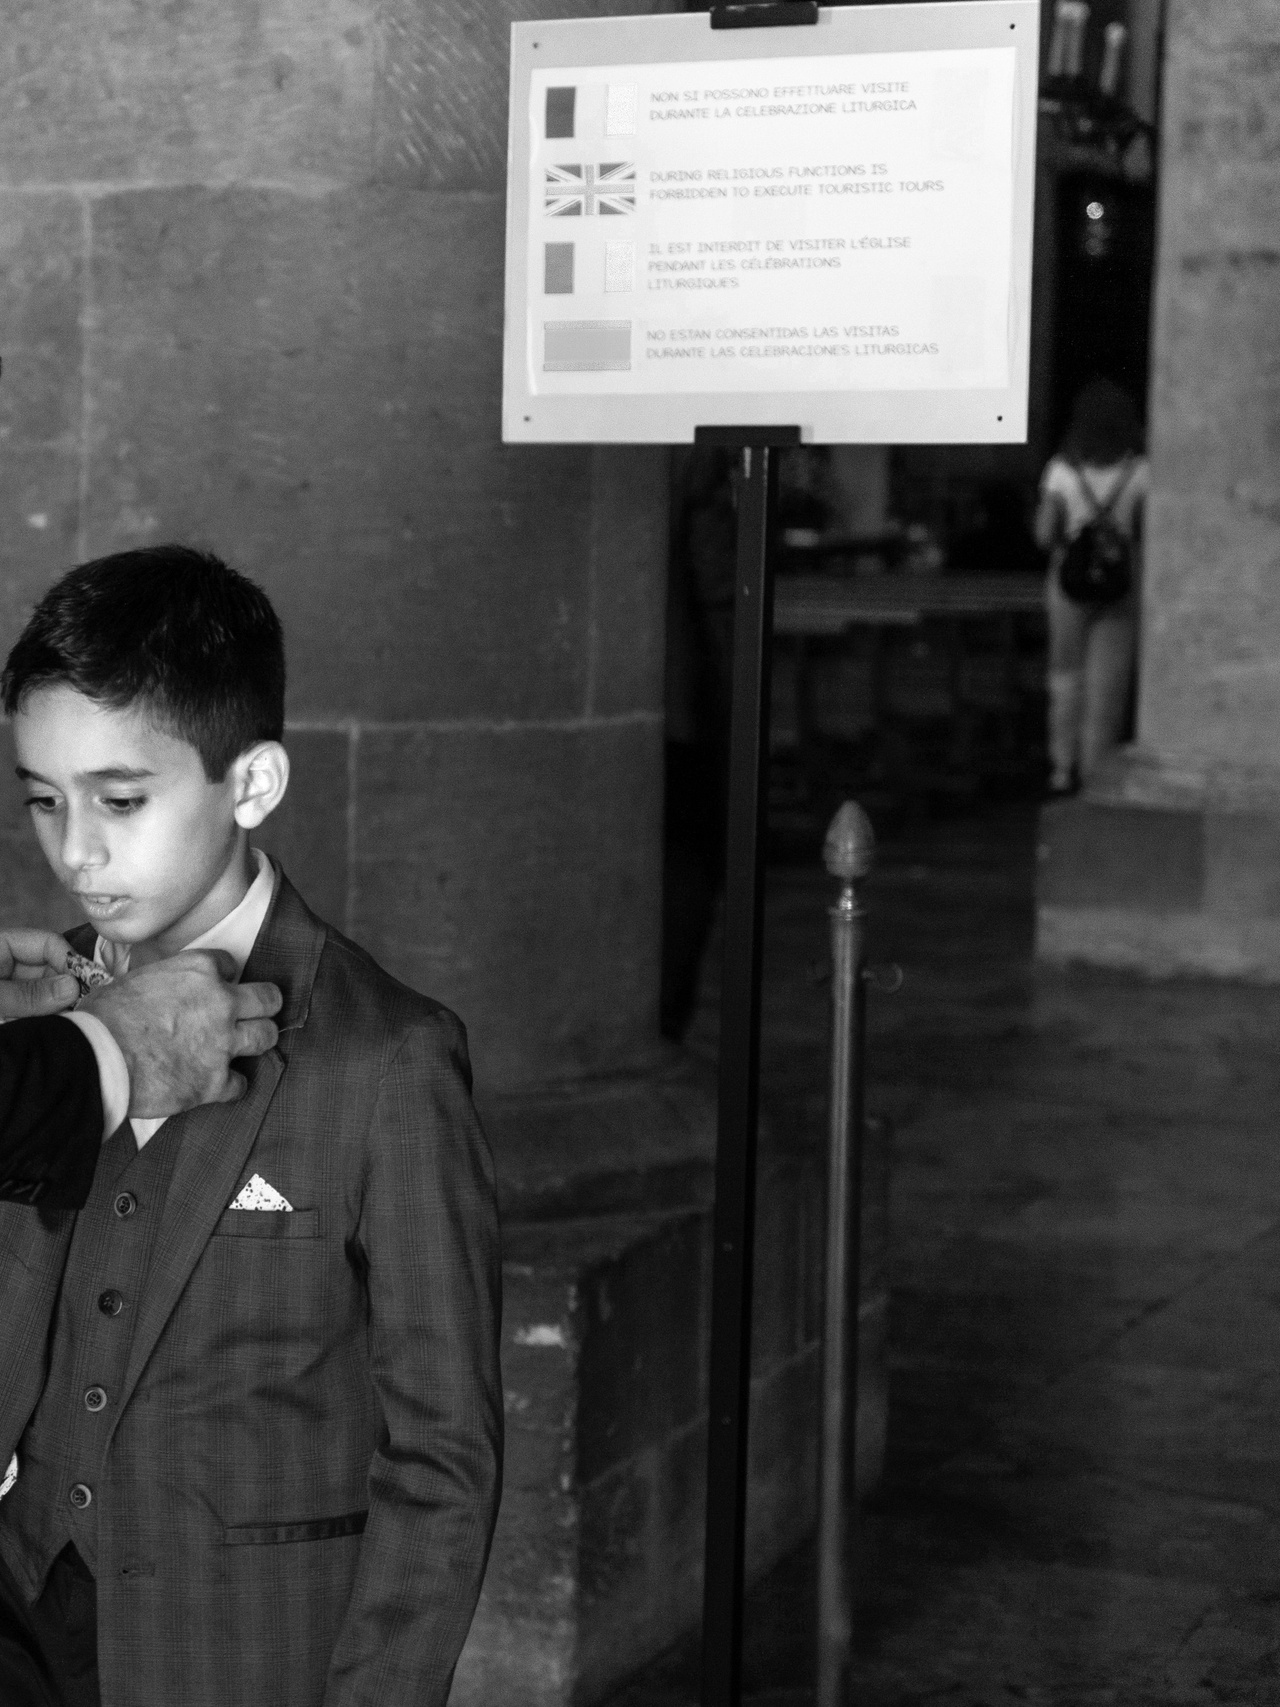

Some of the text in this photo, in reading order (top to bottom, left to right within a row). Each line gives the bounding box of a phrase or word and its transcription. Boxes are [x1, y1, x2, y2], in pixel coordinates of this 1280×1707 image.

[651, 81, 909, 102] NON SI POSSONO EFFETTUARE VISITE
[650, 100, 917, 120] DURANTE LA CELEBRAZIONE LITURGICA
[650, 164, 887, 182] DURING RELIGIOUS FUNCTIONS IS
[650, 180, 944, 200] FORBIDDEN TO EXECUTE TOURISTIC TOURS
[649, 243, 662, 254] IL
[668, 242, 692, 254] EST
[698, 240, 760, 253] INTERDIT
[766, 240, 784, 251] DE
[789, 238, 846, 250] VISITER
[648, 257, 841, 271] PENDANT LES CÉLÉBRATIONS
[648, 277, 739, 290] LITURGIQUES
[647, 326, 899, 340] NO ESTAN CONSENTIDAS LAS VISITAS
[646, 343, 939, 358] DURANTE LAS CELEBRACIONES LITURGICAS
